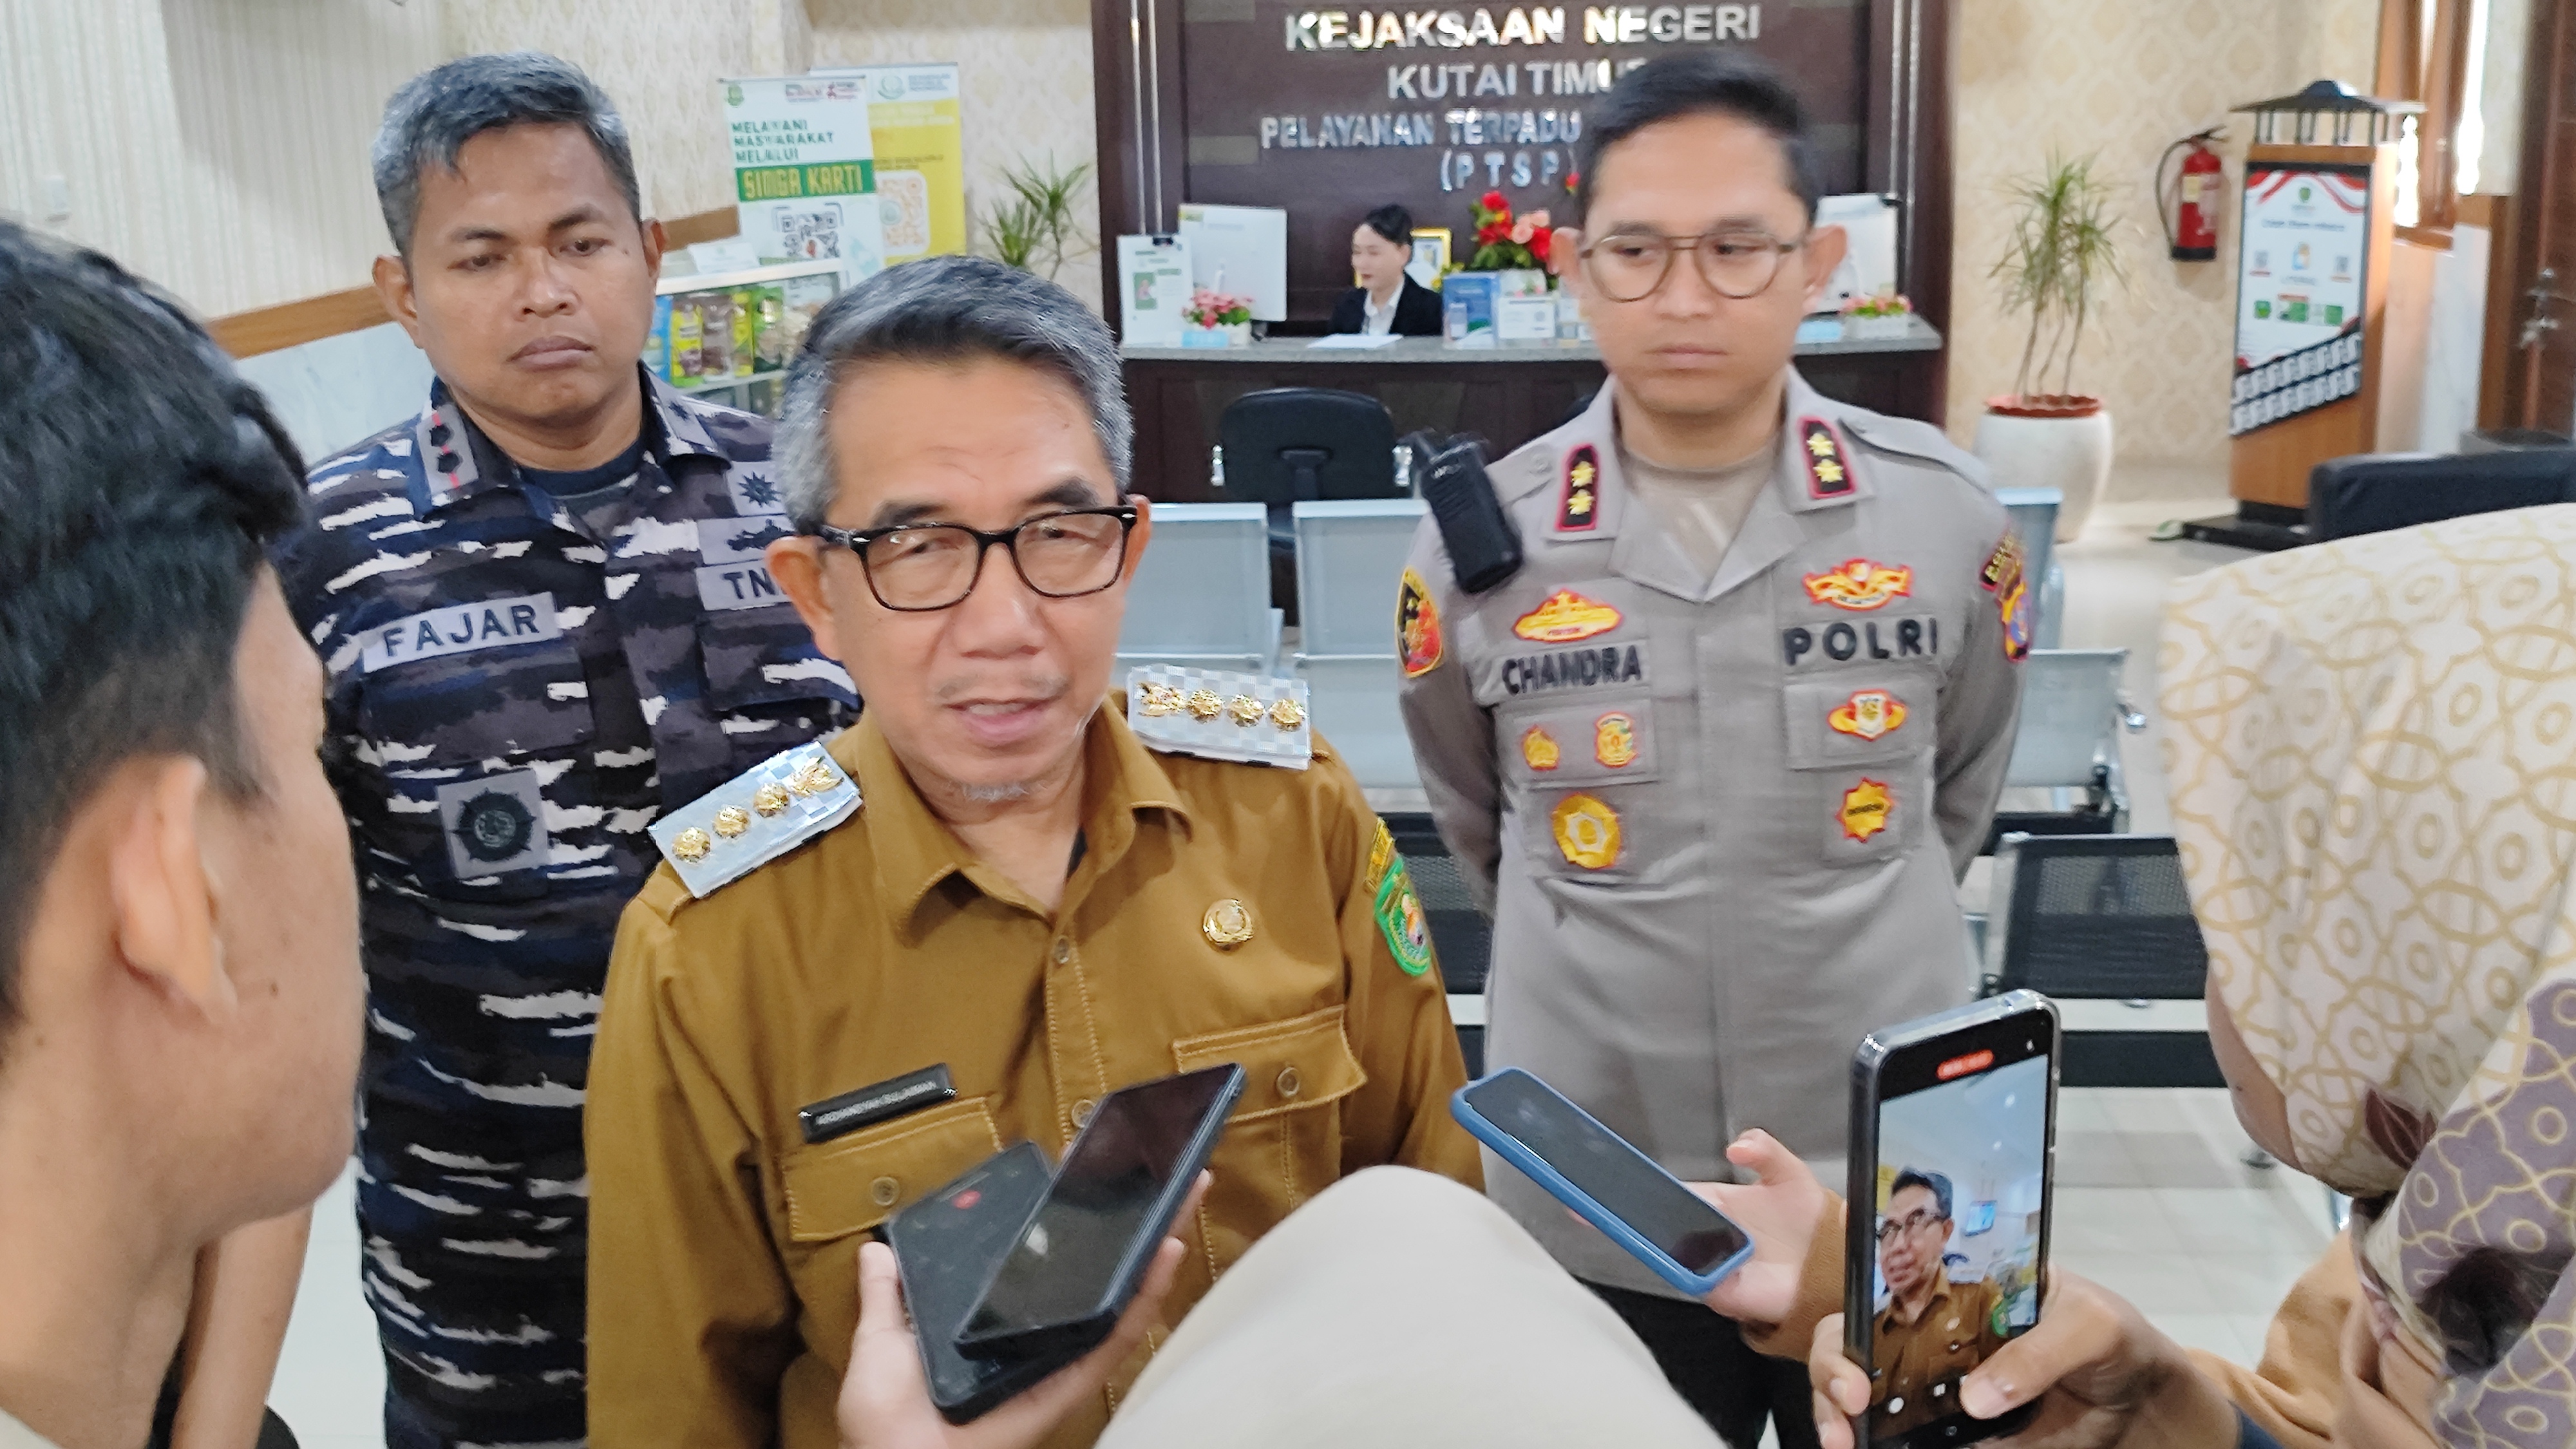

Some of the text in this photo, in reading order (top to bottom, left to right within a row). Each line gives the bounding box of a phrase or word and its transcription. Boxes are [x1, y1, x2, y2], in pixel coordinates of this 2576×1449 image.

[1286, 3, 1761, 51] KEJAKSAAN NEGERI
[1387, 62, 1517, 99] KUTAI
[1261, 106, 1582, 149] PELAYANAN TERPADU
[807, 164, 863, 194] KARTI
[383, 605, 540, 656] FAJAR
[1783, 617, 1937, 666] POLRI
[1502, 645, 1641, 696] CHANDRA
